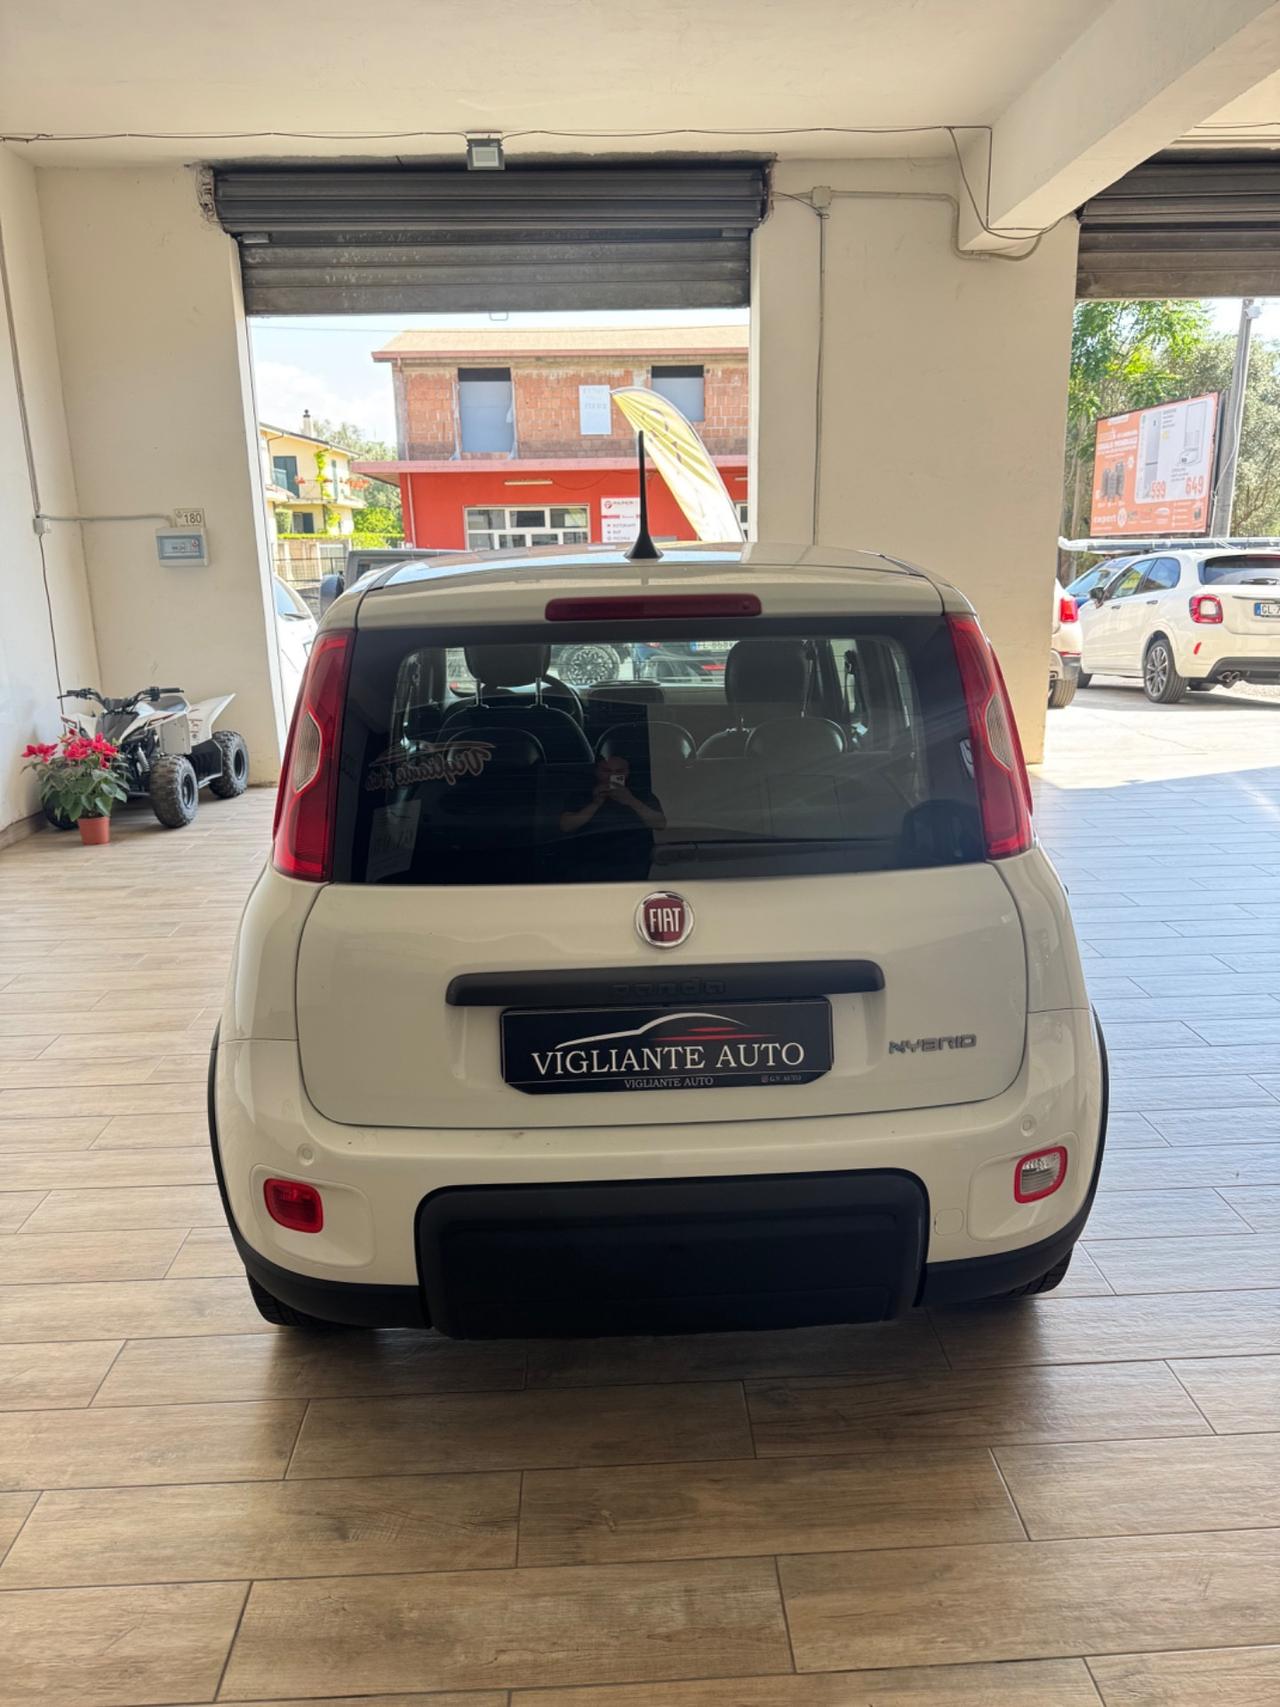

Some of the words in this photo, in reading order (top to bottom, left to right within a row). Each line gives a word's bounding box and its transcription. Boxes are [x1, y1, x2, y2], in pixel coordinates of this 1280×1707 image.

[649, 907, 681, 933] FIAT
[531, 1047, 705, 1075] VIGLIANTE
[715, 1042, 805, 1068] AUTO
[624, 1078, 681, 1089] VIGLIANTE
[682, 1076, 714, 1087] AUTO
